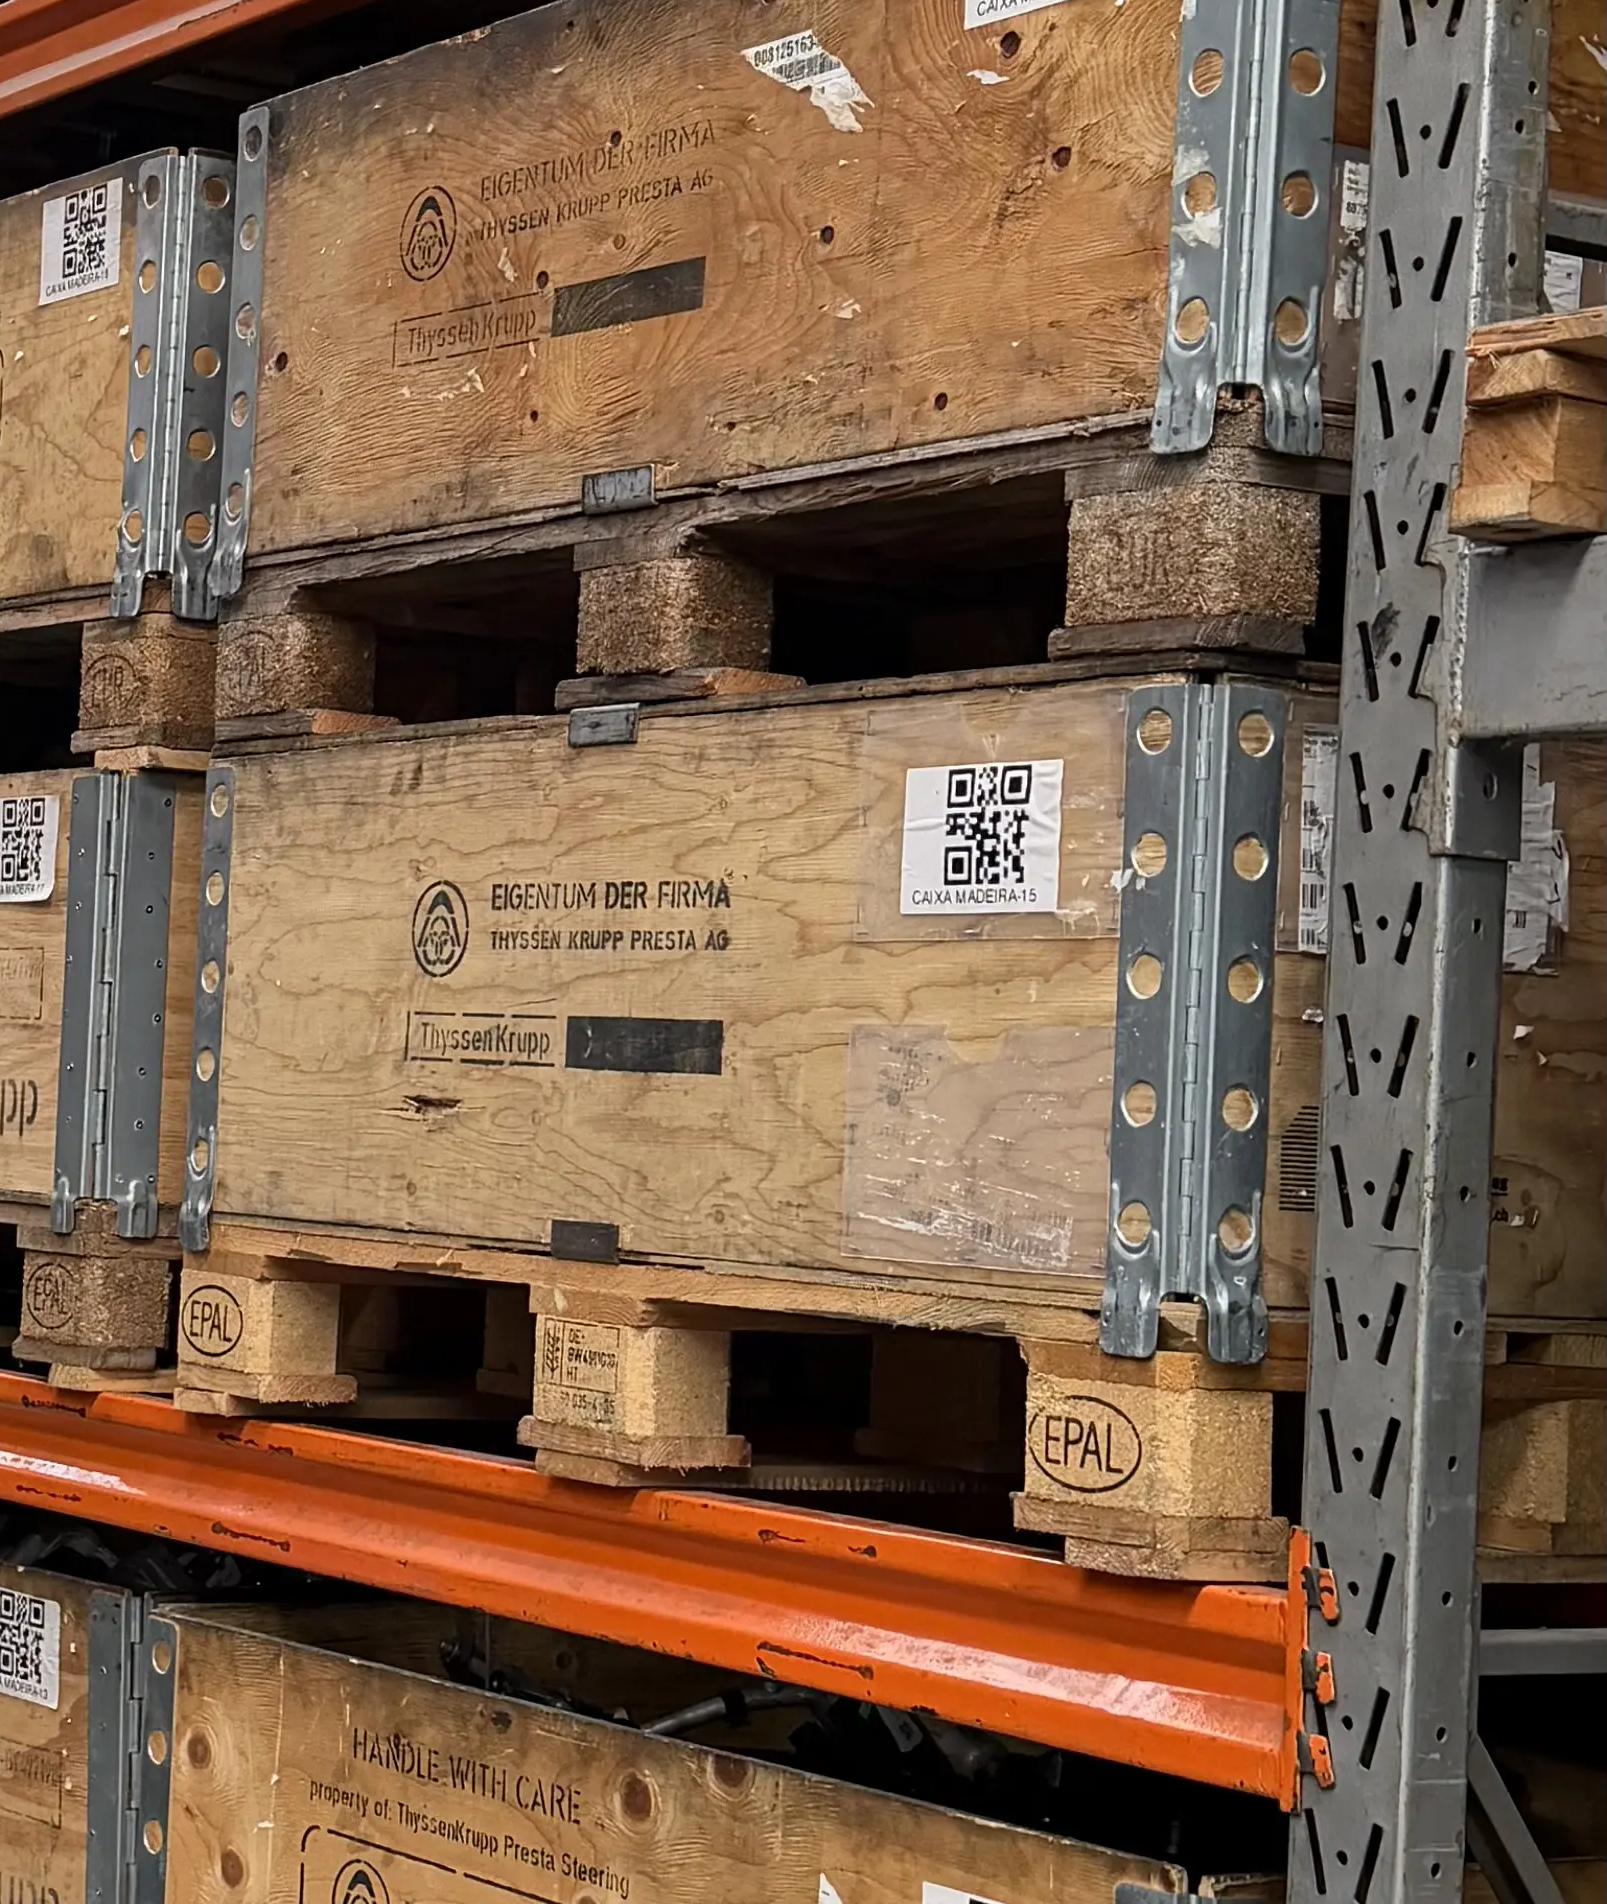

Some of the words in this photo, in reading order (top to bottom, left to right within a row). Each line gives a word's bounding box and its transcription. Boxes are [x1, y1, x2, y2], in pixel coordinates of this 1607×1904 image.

[479, 153, 587, 202] EIGENTUM
[594, 141, 636, 173] DER
[644, 119, 717, 164] FIRMA
[477, 210, 549, 241] THYSSEN
[556, 192, 610, 223] KRUPP
[617, 176, 683, 210] PRESTA
[691, 169, 715, 191] AG
[407, 309, 537, 357] ThyssenKrupp
[490, 883, 597, 911] EIGENTUM
[604, 881, 648, 910] DER
[657, 880, 732, 909] FIRMA
[912, 888, 953, 905] CAIXA
[955, 887, 1038, 904] MADEIRA-15
[490, 928, 561, 951] THYSSEN
[567, 928, 624, 951] KRUPP
[630, 928, 697, 951] PRESTA
[704, 929, 731, 951] AG
[421, 1021, 551, 1061] ThyssenKrupp
[189, 1299, 233, 1344] EPAL
[1044, 1415, 1124, 1475] EPAL
[352, 1729, 440, 1785] HANDLE
[447, 1754, 508, 1805] WITH
[516, 1772, 582, 1826] CARE
[309, 1779, 369, 1820] property
[397, 1800, 499, 1856] ThyssenKrupp
[503, 1834, 556, 1873] Presta
[561, 1851, 630, 1900] Steering
